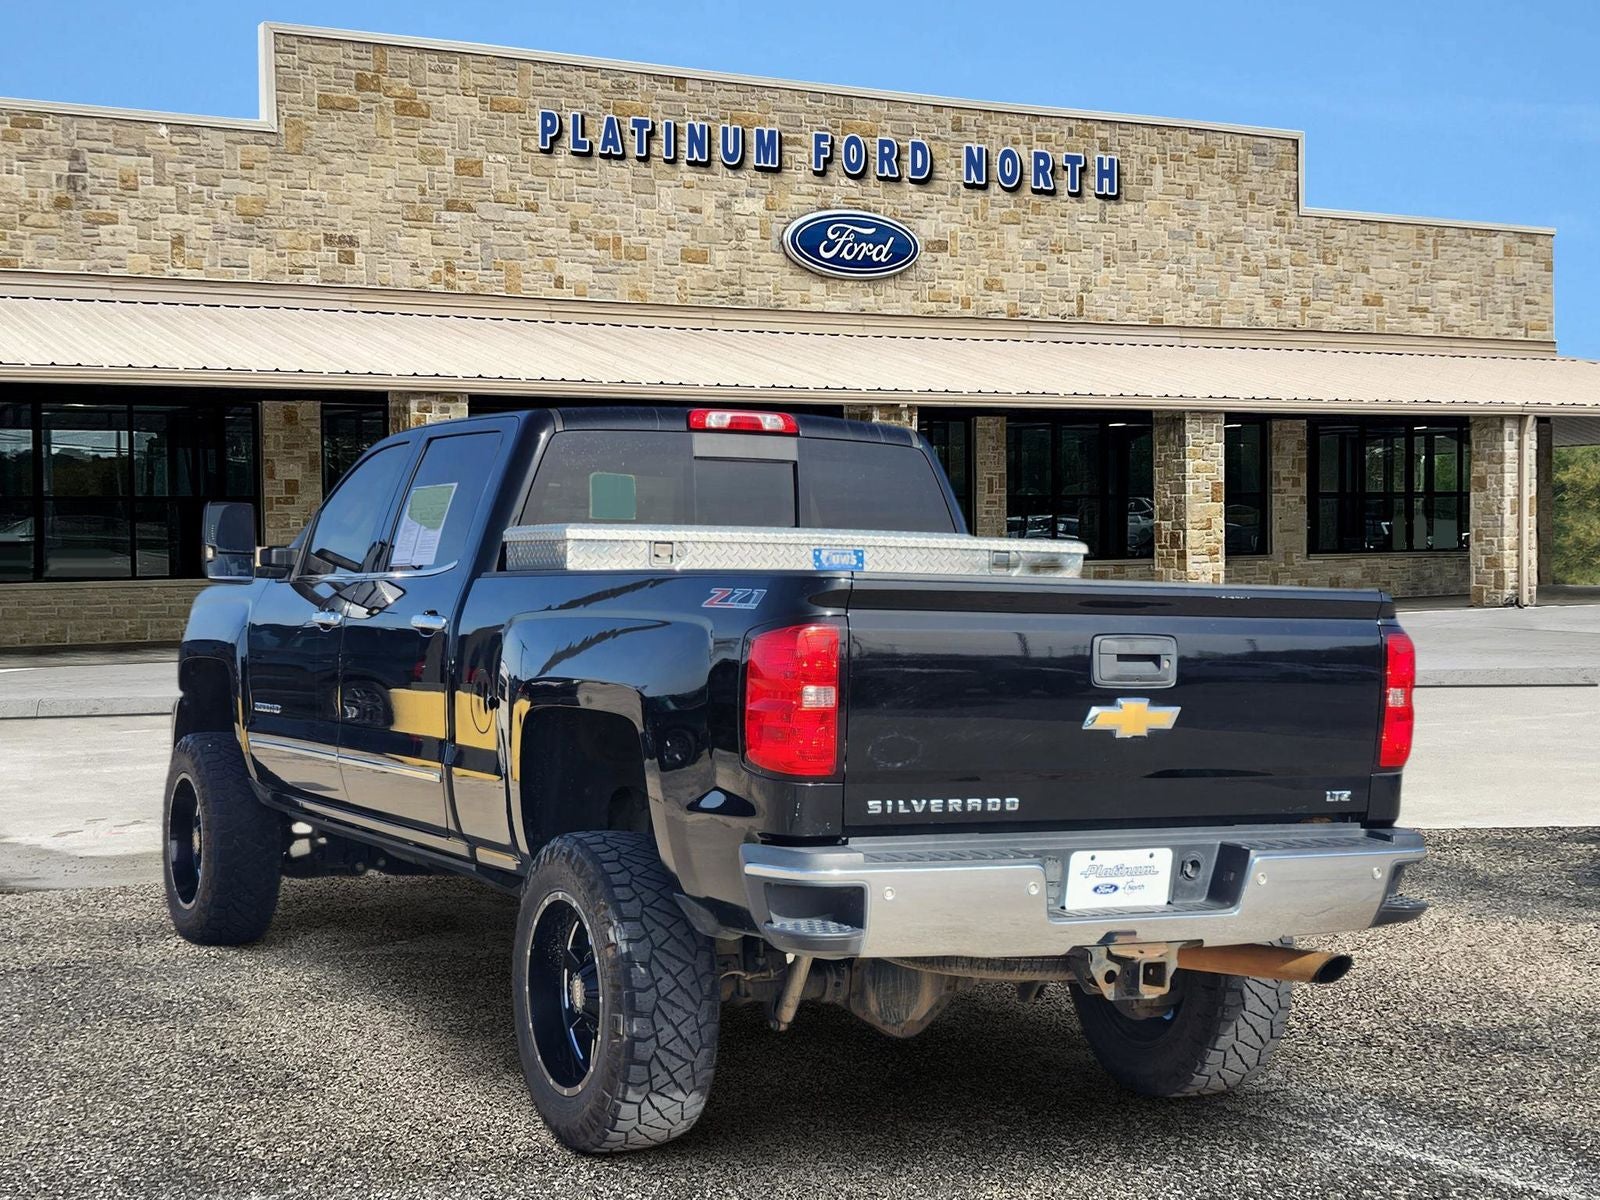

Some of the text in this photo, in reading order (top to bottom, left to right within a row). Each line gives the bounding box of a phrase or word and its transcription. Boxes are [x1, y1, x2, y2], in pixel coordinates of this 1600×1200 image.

[539, 109, 1121, 198] PLATINUM FORD NORTH
[819, 223, 894, 262] Ford
[701, 587, 768, 609] Z71
[867, 797, 1020, 814] SILVERADO
[1325, 790, 1352, 802] LTZ
[1080, 864, 1159, 878] Platinum
